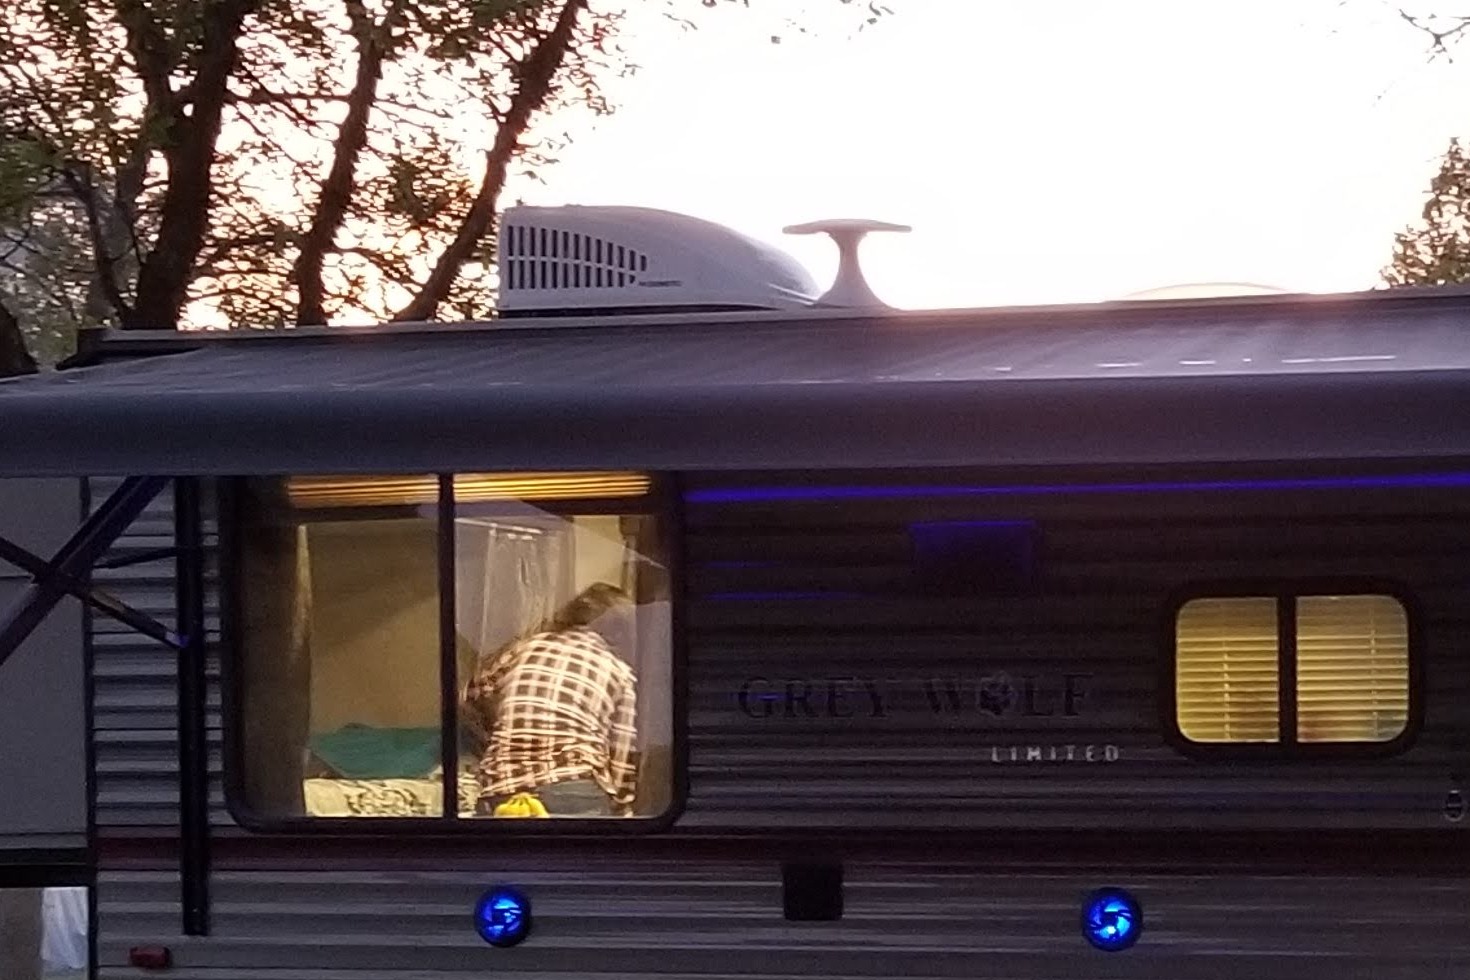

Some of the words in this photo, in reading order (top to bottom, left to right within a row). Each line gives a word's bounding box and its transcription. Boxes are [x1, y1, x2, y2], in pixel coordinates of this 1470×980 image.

[738, 675, 892, 718] GREY
[922, 671, 1095, 717] WOLF
[990, 745, 1120, 763] LIMITED
